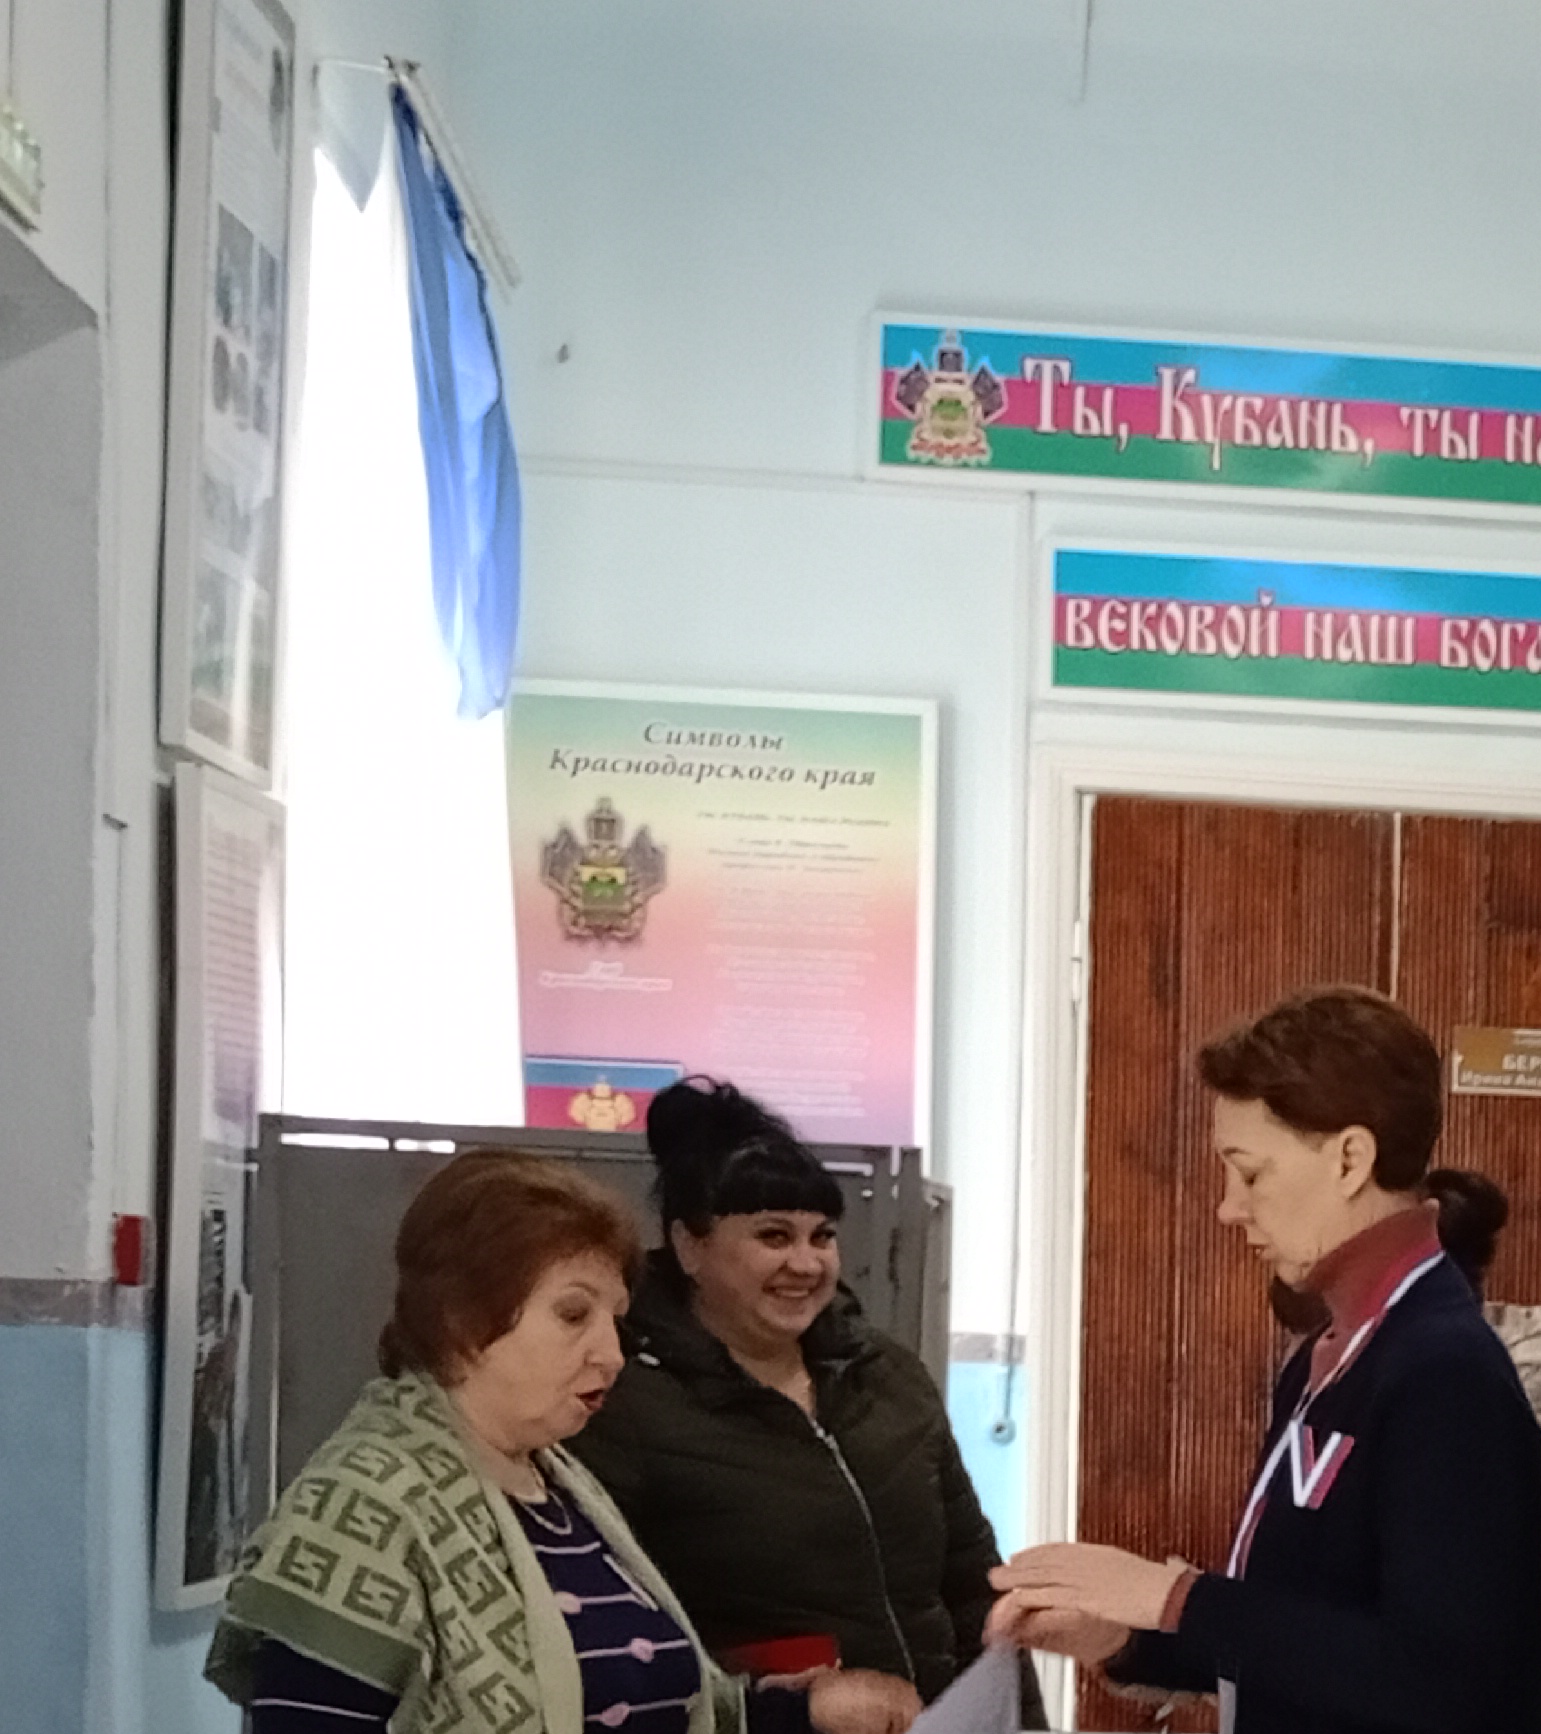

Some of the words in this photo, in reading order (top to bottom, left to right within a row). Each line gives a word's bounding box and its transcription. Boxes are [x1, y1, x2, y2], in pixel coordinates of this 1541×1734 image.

[1022, 355, 1130, 451] Ты,
[1157, 366, 1374, 469] Кубань,
[1400, 404, 1480, 460] ты
[643, 720, 784, 751] Символы
[549, 749, 795, 783] Краснодарского
[804, 767, 877, 789] края
